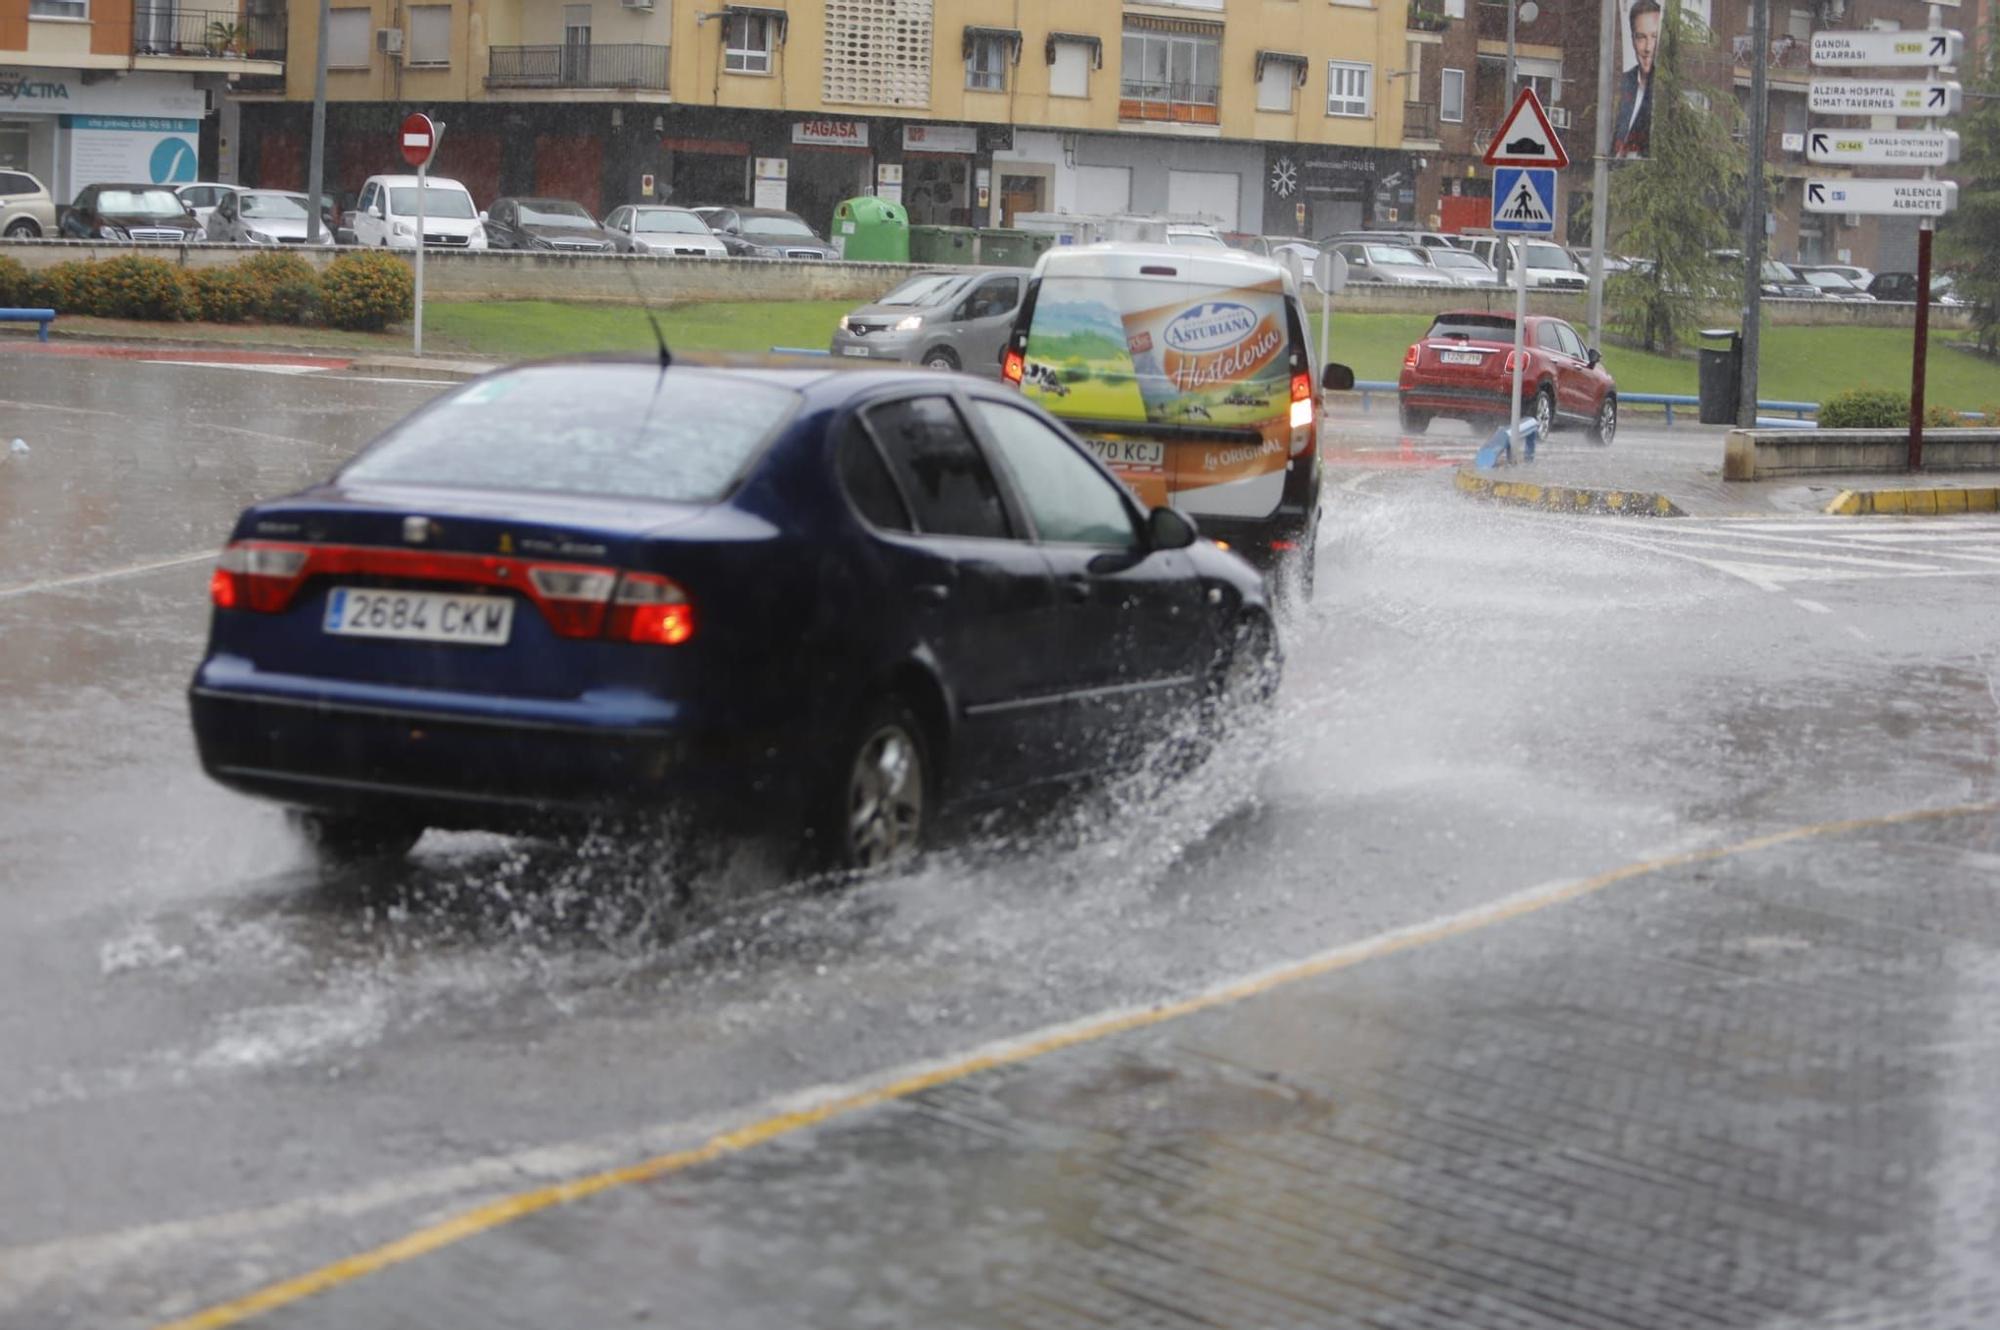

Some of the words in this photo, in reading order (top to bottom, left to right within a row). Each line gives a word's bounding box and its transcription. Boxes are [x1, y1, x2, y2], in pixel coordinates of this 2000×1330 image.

[802, 120, 859, 138] FAGASA
[1894, 187, 1943, 198] VALENCIA
[1892, 200, 1942, 210] ALBACETE
[1171, 316, 1250, 345] ASTURIANA
[1123, 442, 1161, 463] KCJ
[1219, 438, 1284, 466] ORIGINAL
[350, 595, 429, 630] 2684
[440, 601, 504, 635] CKW
